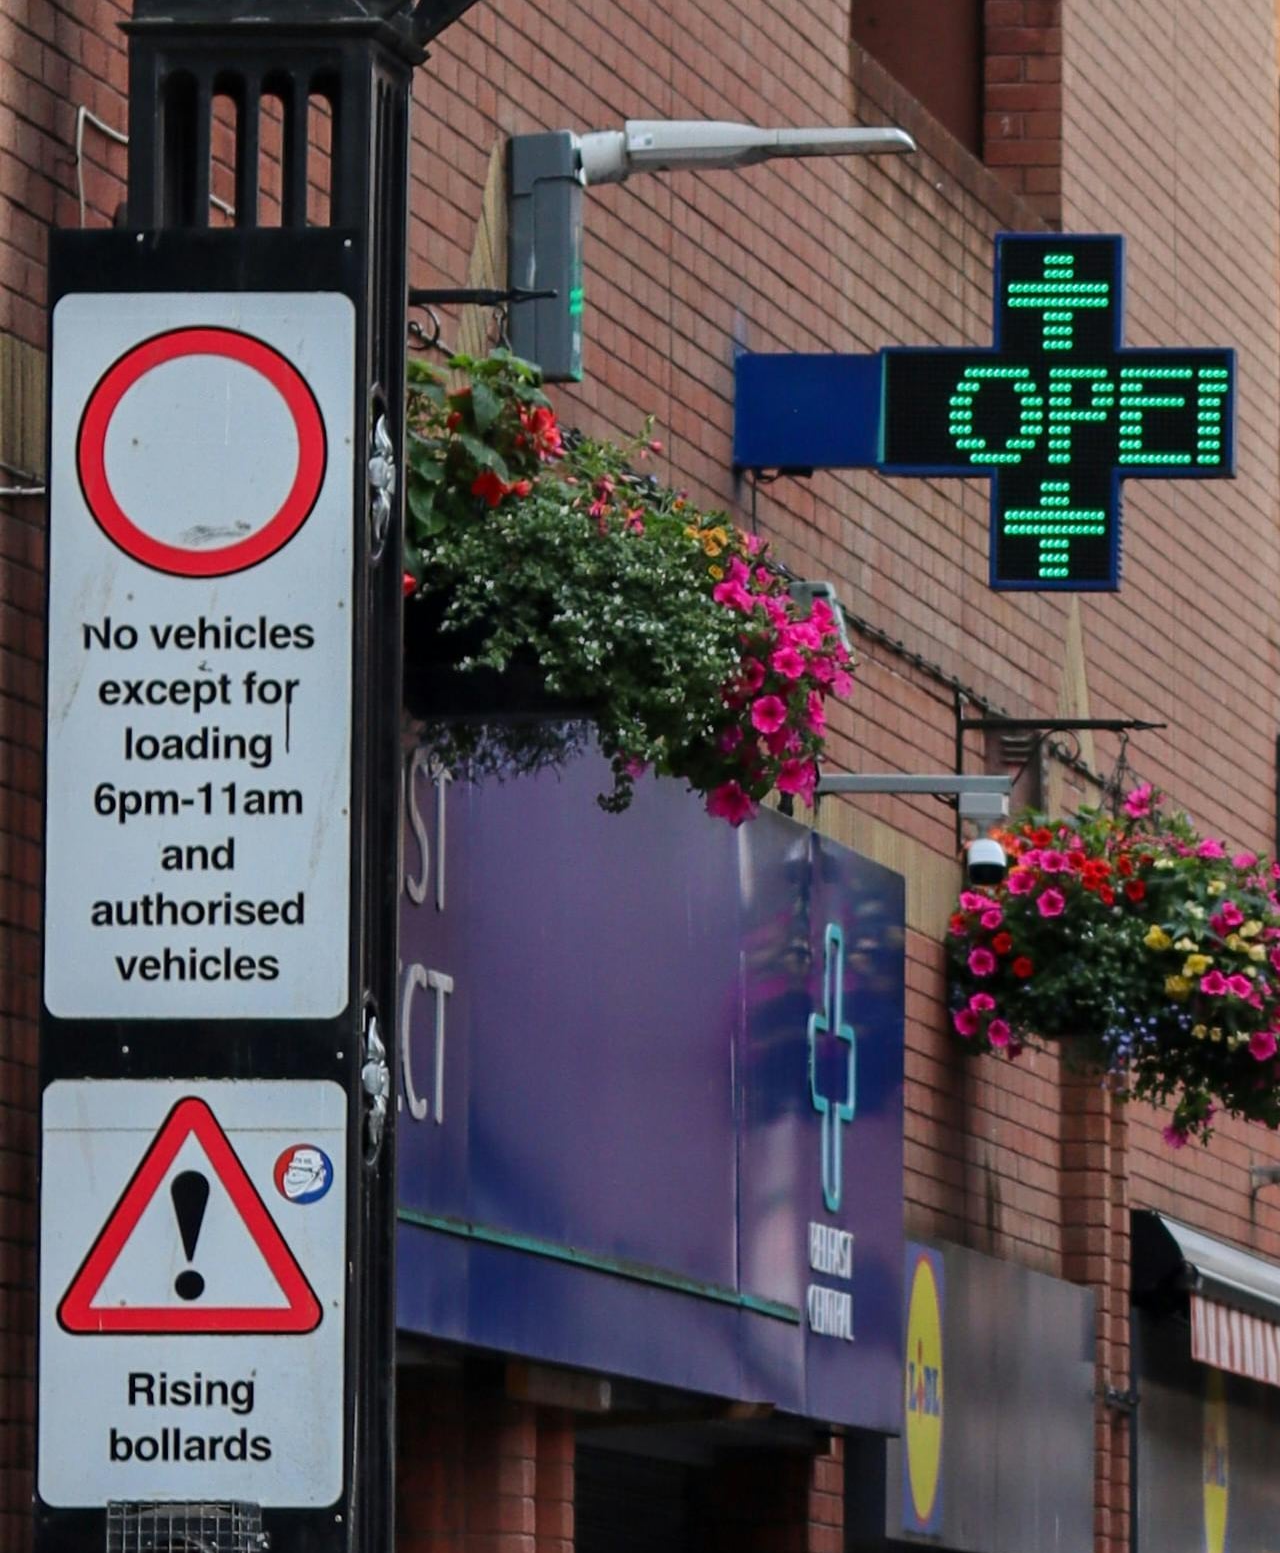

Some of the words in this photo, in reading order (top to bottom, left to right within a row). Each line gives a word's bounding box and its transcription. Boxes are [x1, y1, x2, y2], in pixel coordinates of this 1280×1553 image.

[83, 617, 138, 650] No
[150, 616, 315, 650] vehicles
[98, 674, 231, 714] except
[243, 671, 300, 706] for
[125, 726, 272, 769] loading
[94, 782, 303, 824] 6pm-11am
[161, 837, 235, 871] and
[91, 891, 305, 927] authorised
[115, 947, 280, 981] vehicles
[128, 1372, 255, 1415] Rising
[110, 1427, 272, 1462] bollards
